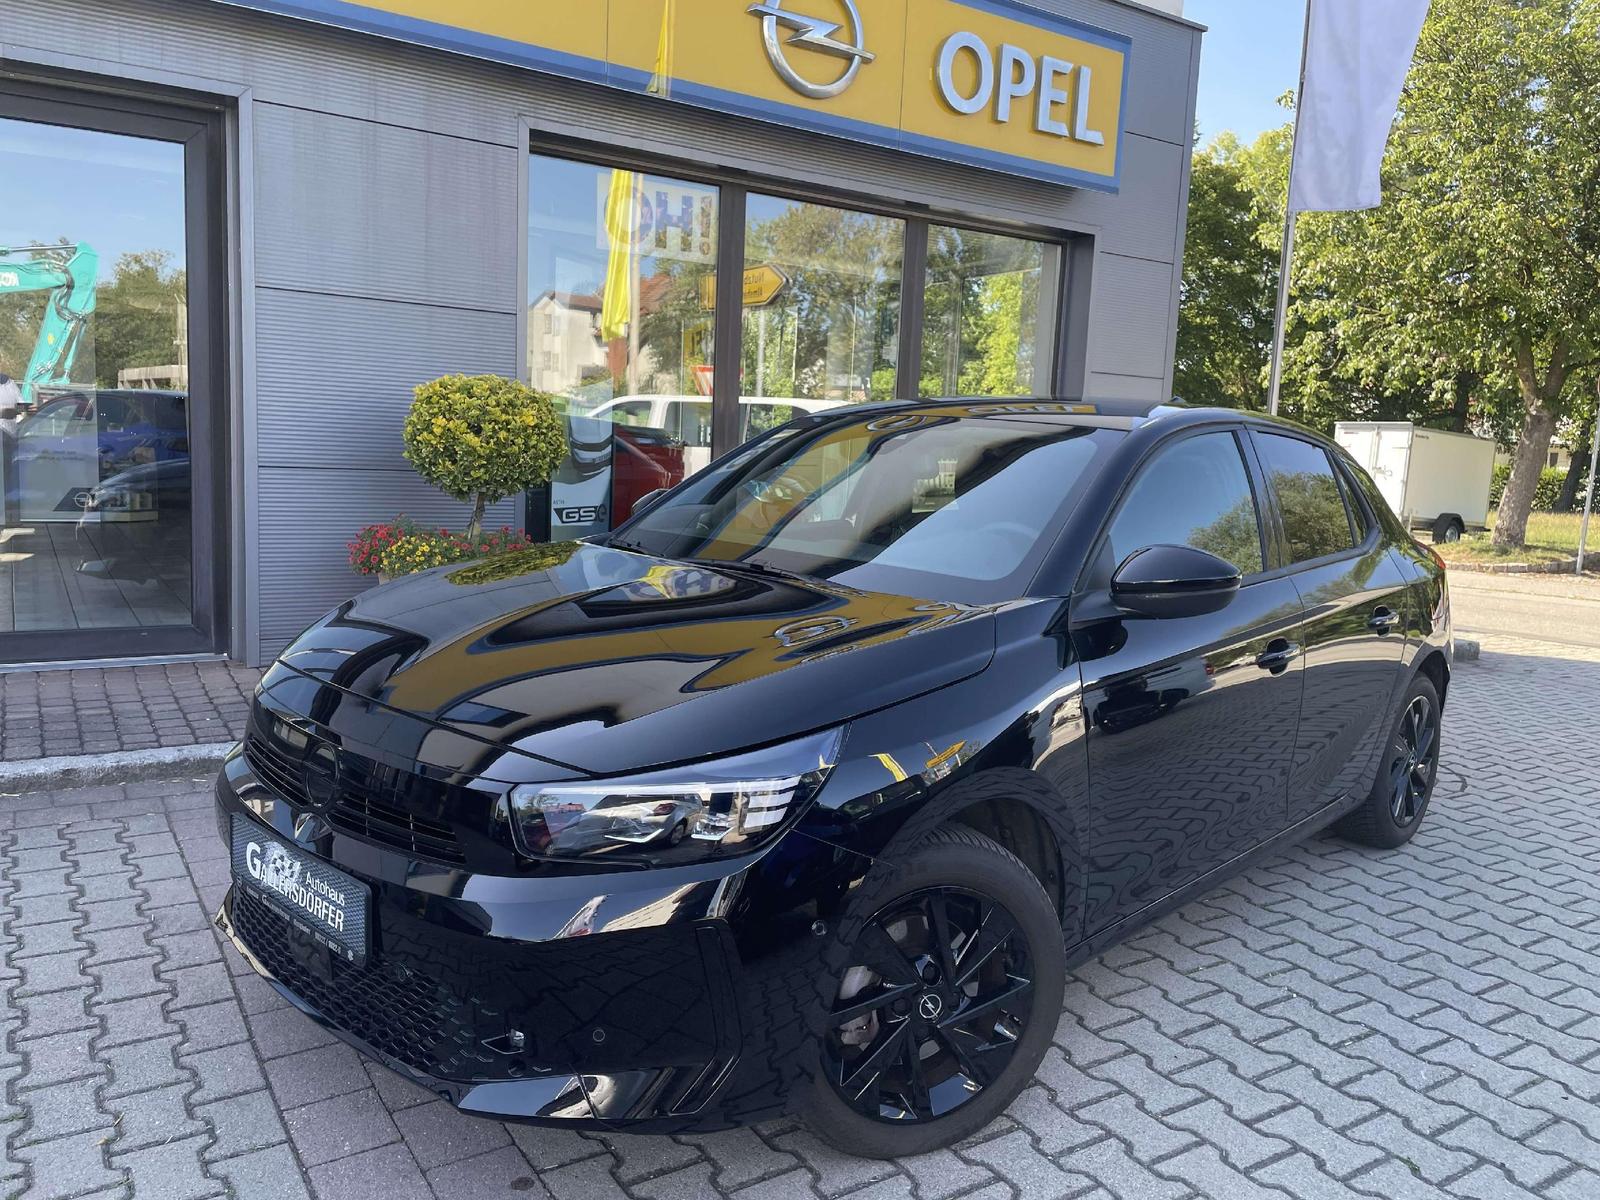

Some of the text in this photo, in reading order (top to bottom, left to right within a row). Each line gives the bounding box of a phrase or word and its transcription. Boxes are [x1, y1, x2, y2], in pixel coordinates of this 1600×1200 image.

[935, 31, 1105, 147] OPEL
[604, 185, 713, 256] OH!
[305, 871, 346, 906] Autohaus
